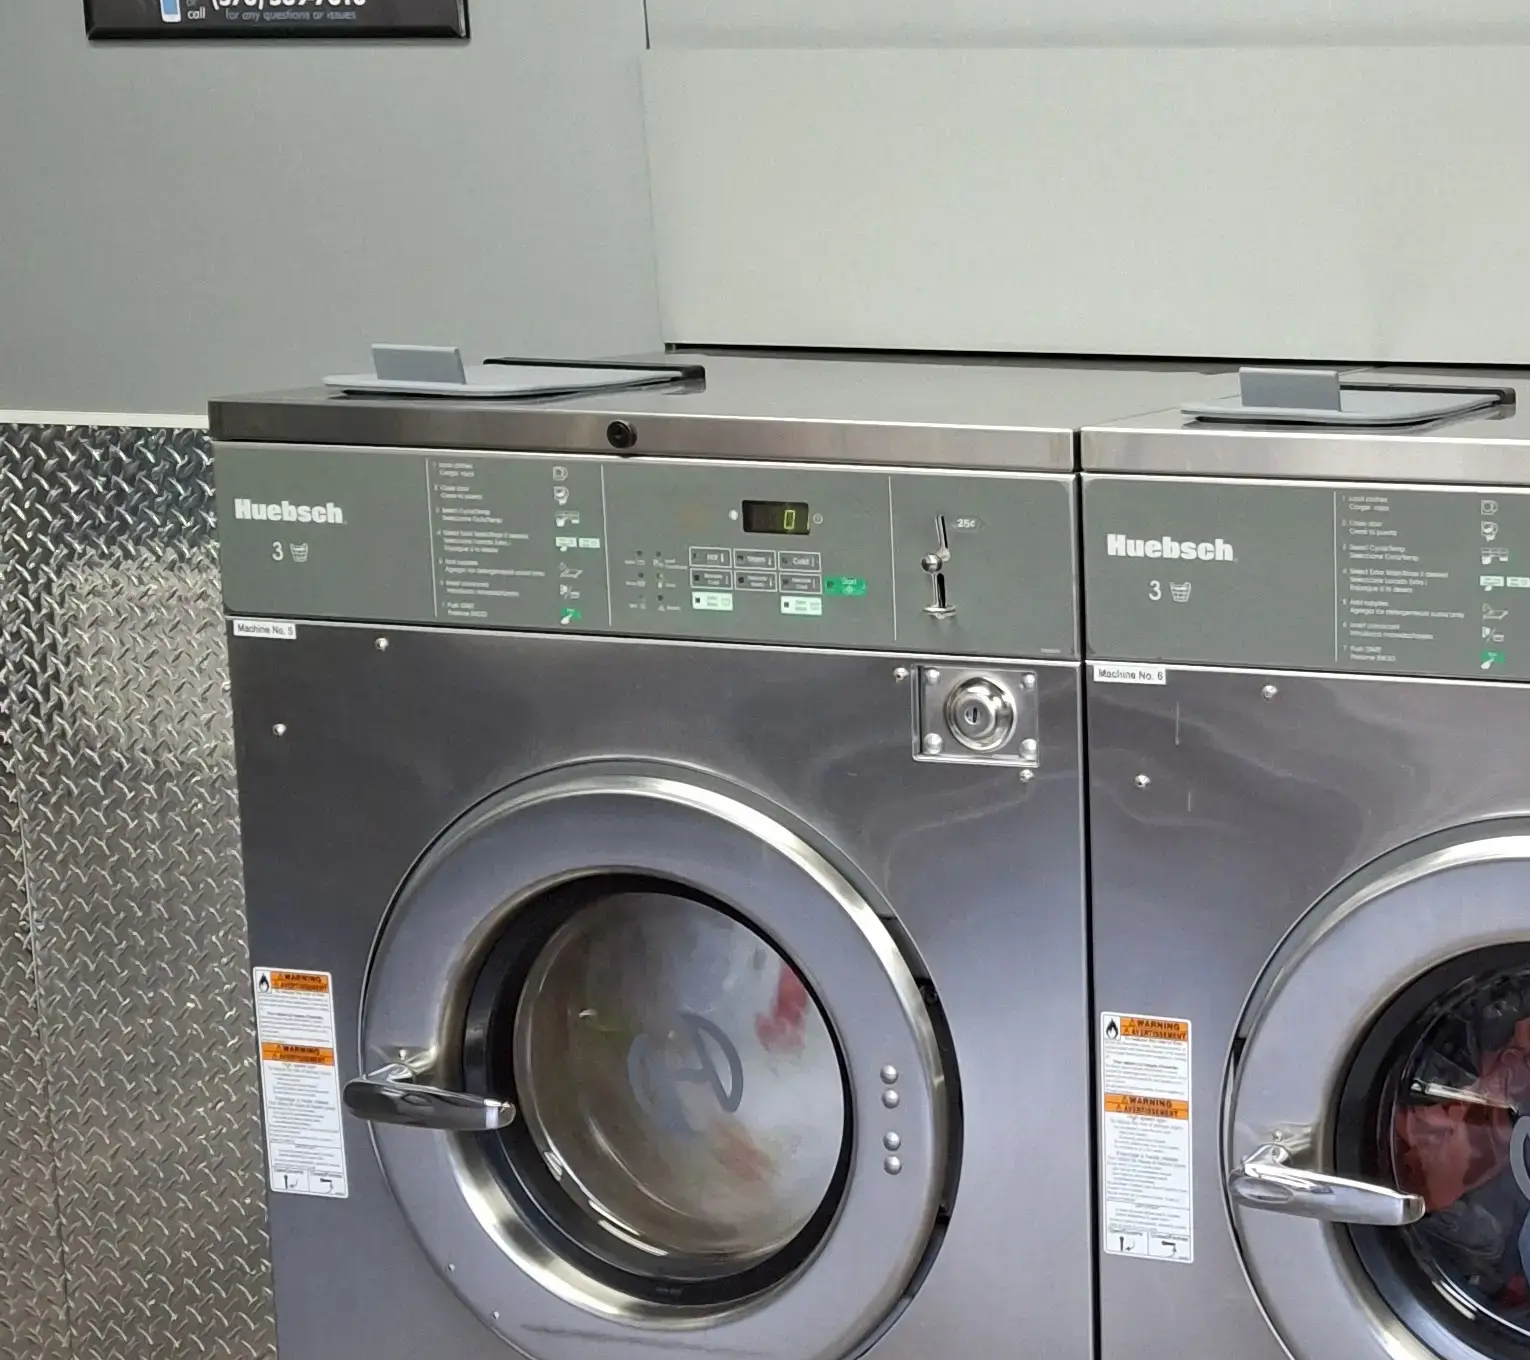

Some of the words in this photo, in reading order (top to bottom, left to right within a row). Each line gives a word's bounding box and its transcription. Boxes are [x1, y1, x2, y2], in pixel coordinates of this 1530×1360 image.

[188, 7, 206, 20] call
[263, 8, 310, 22] questions
[234, 498, 343, 525] Huebsch
[272, 541, 284, 561] 3
[1106, 533, 1234, 562] Huebsch
[1148, 580, 1162, 601] 3
[272, 625, 286, 635] No.
[287, 626, 294, 636] 5
[1157, 671, 1164, 681] 6
[1137, 1019, 1181, 1031] WARNING
[1128, 1096, 1173, 1109] WARNING
